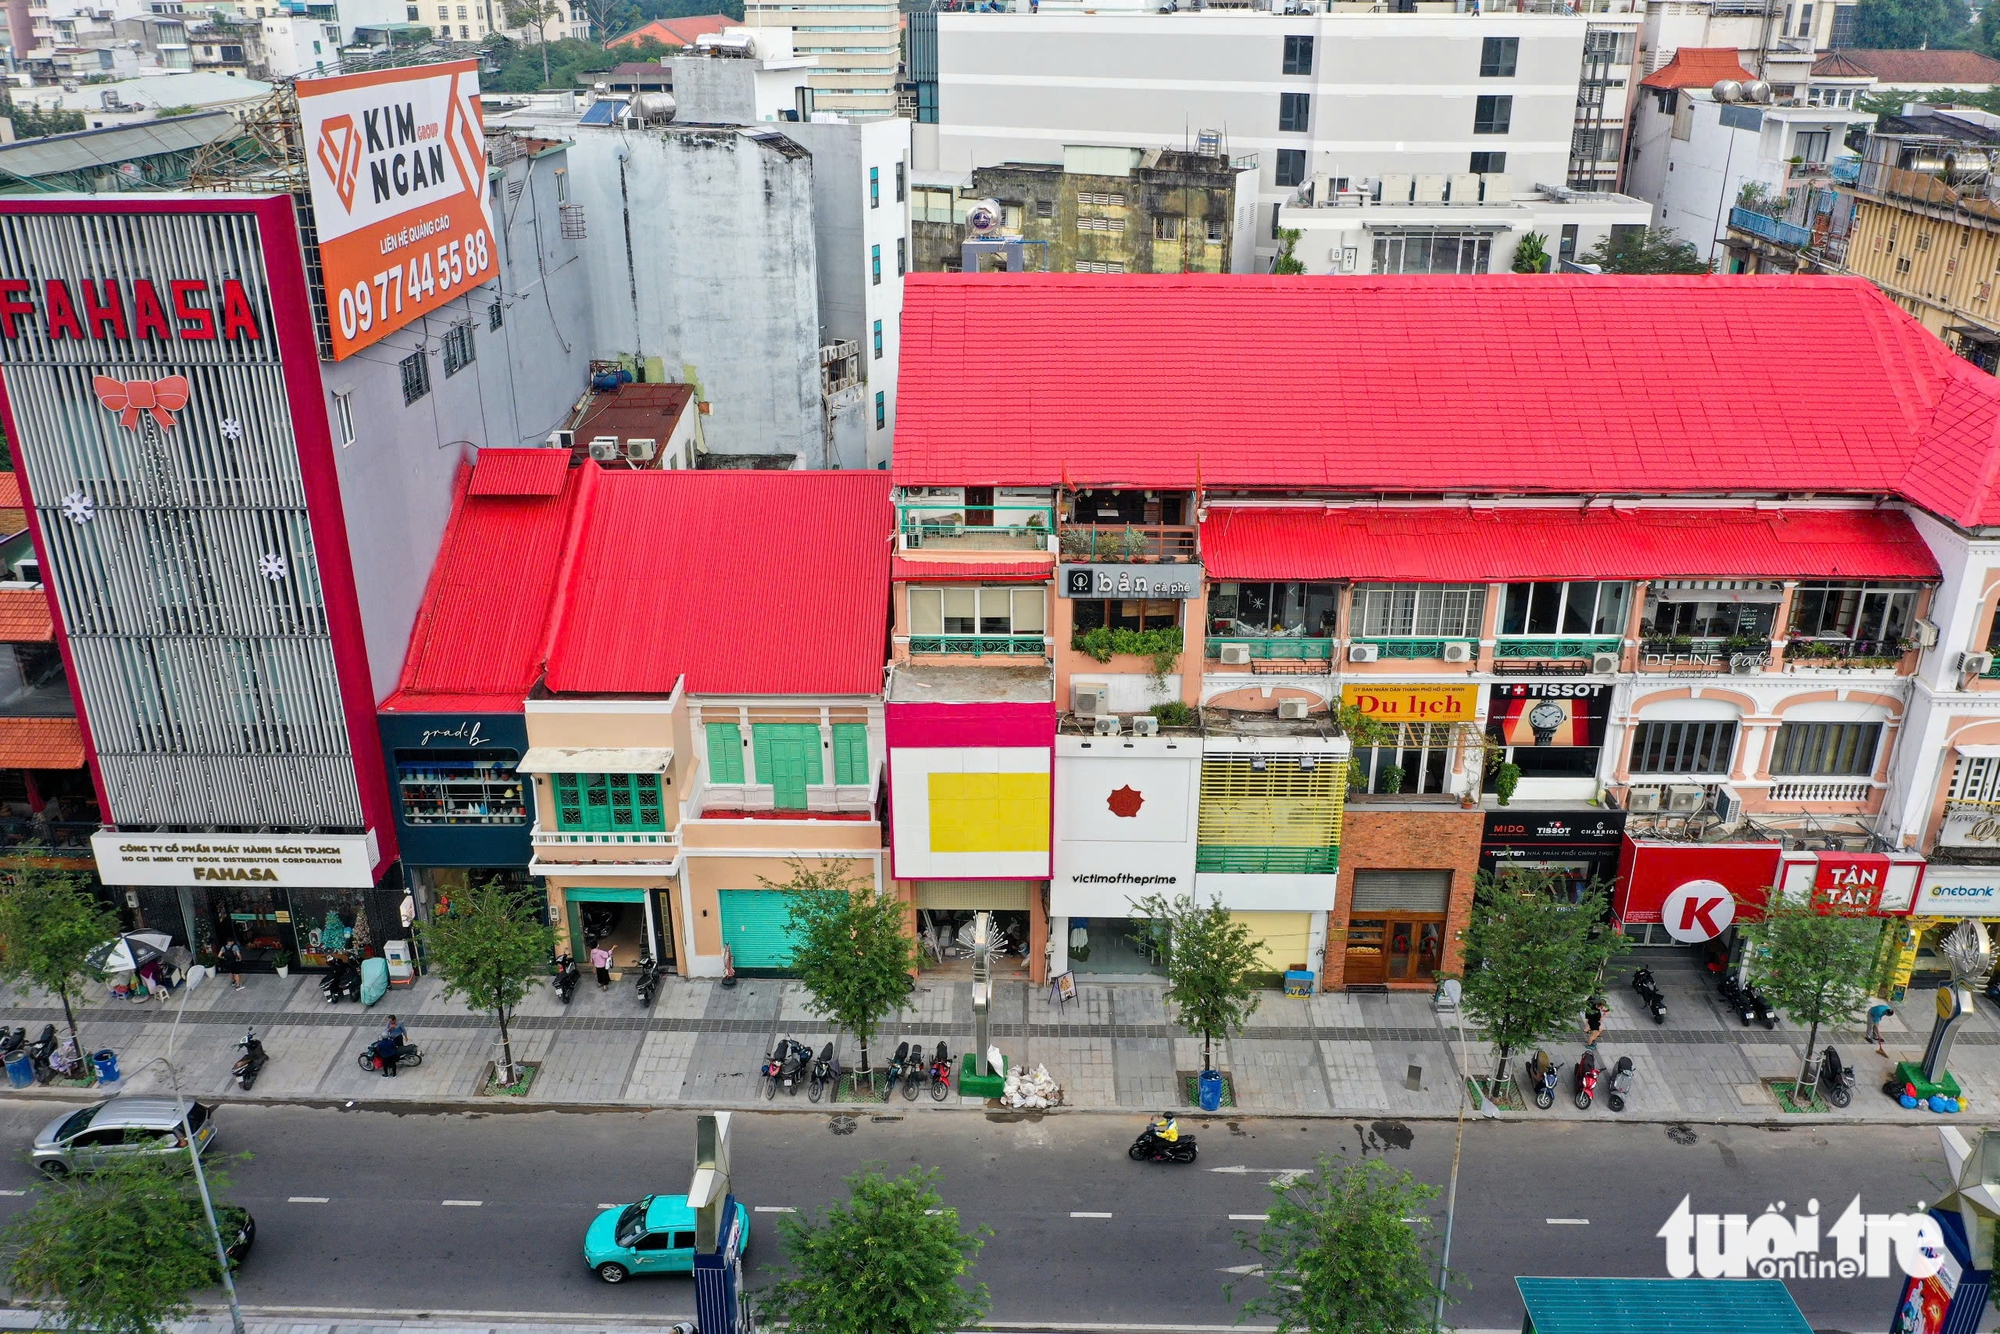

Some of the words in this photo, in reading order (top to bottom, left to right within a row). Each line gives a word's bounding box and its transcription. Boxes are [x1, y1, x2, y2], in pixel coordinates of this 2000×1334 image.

[363, 102, 416, 154] KIM
[417, 122, 439, 140] GROUP
[370, 144, 445, 204] NGAN
[380, 233, 398, 254] LIÊN
[398, 230, 408, 248] HỆ
[410, 220, 434, 244] QUẢNG
[434, 214, 450, 234] CÁO
[338, 280, 373, 340] 09
[374, 264, 403, 320] 77
[408, 253, 434, 302] 44
[438, 240, 462, 290] 55
[464, 228, 488, 276] 88
[0, 279, 260, 340] FAHASA
[1098, 572, 1148, 592] bản
[1154, 582, 1168, 592] cà
[1170, 582, 1190, 594] phê
[1646, 654, 1722, 666] DEFINE
[1528, 684, 1604, 696] TISSOT
[1356, 695, 1397, 713] Du
[1408, 695, 1461, 718] lịch
[120, 844, 148, 852] CÔNG
[165, 843, 179, 852] CỔ
[182, 844, 210, 852] PHẦN
[212, 844, 240, 853] PHÁT
[243, 845, 272, 854] HÀNH
[275, 846, 302, 854] SÁCH
[193, 867, 278, 882] FAHASA
[1072, 873, 1176, 886] victimoftheprime
[1831, 864, 1878, 884] TÂN
[1826, 886, 1872, 904] TÂN
[1679, 897, 1725, 938] K
